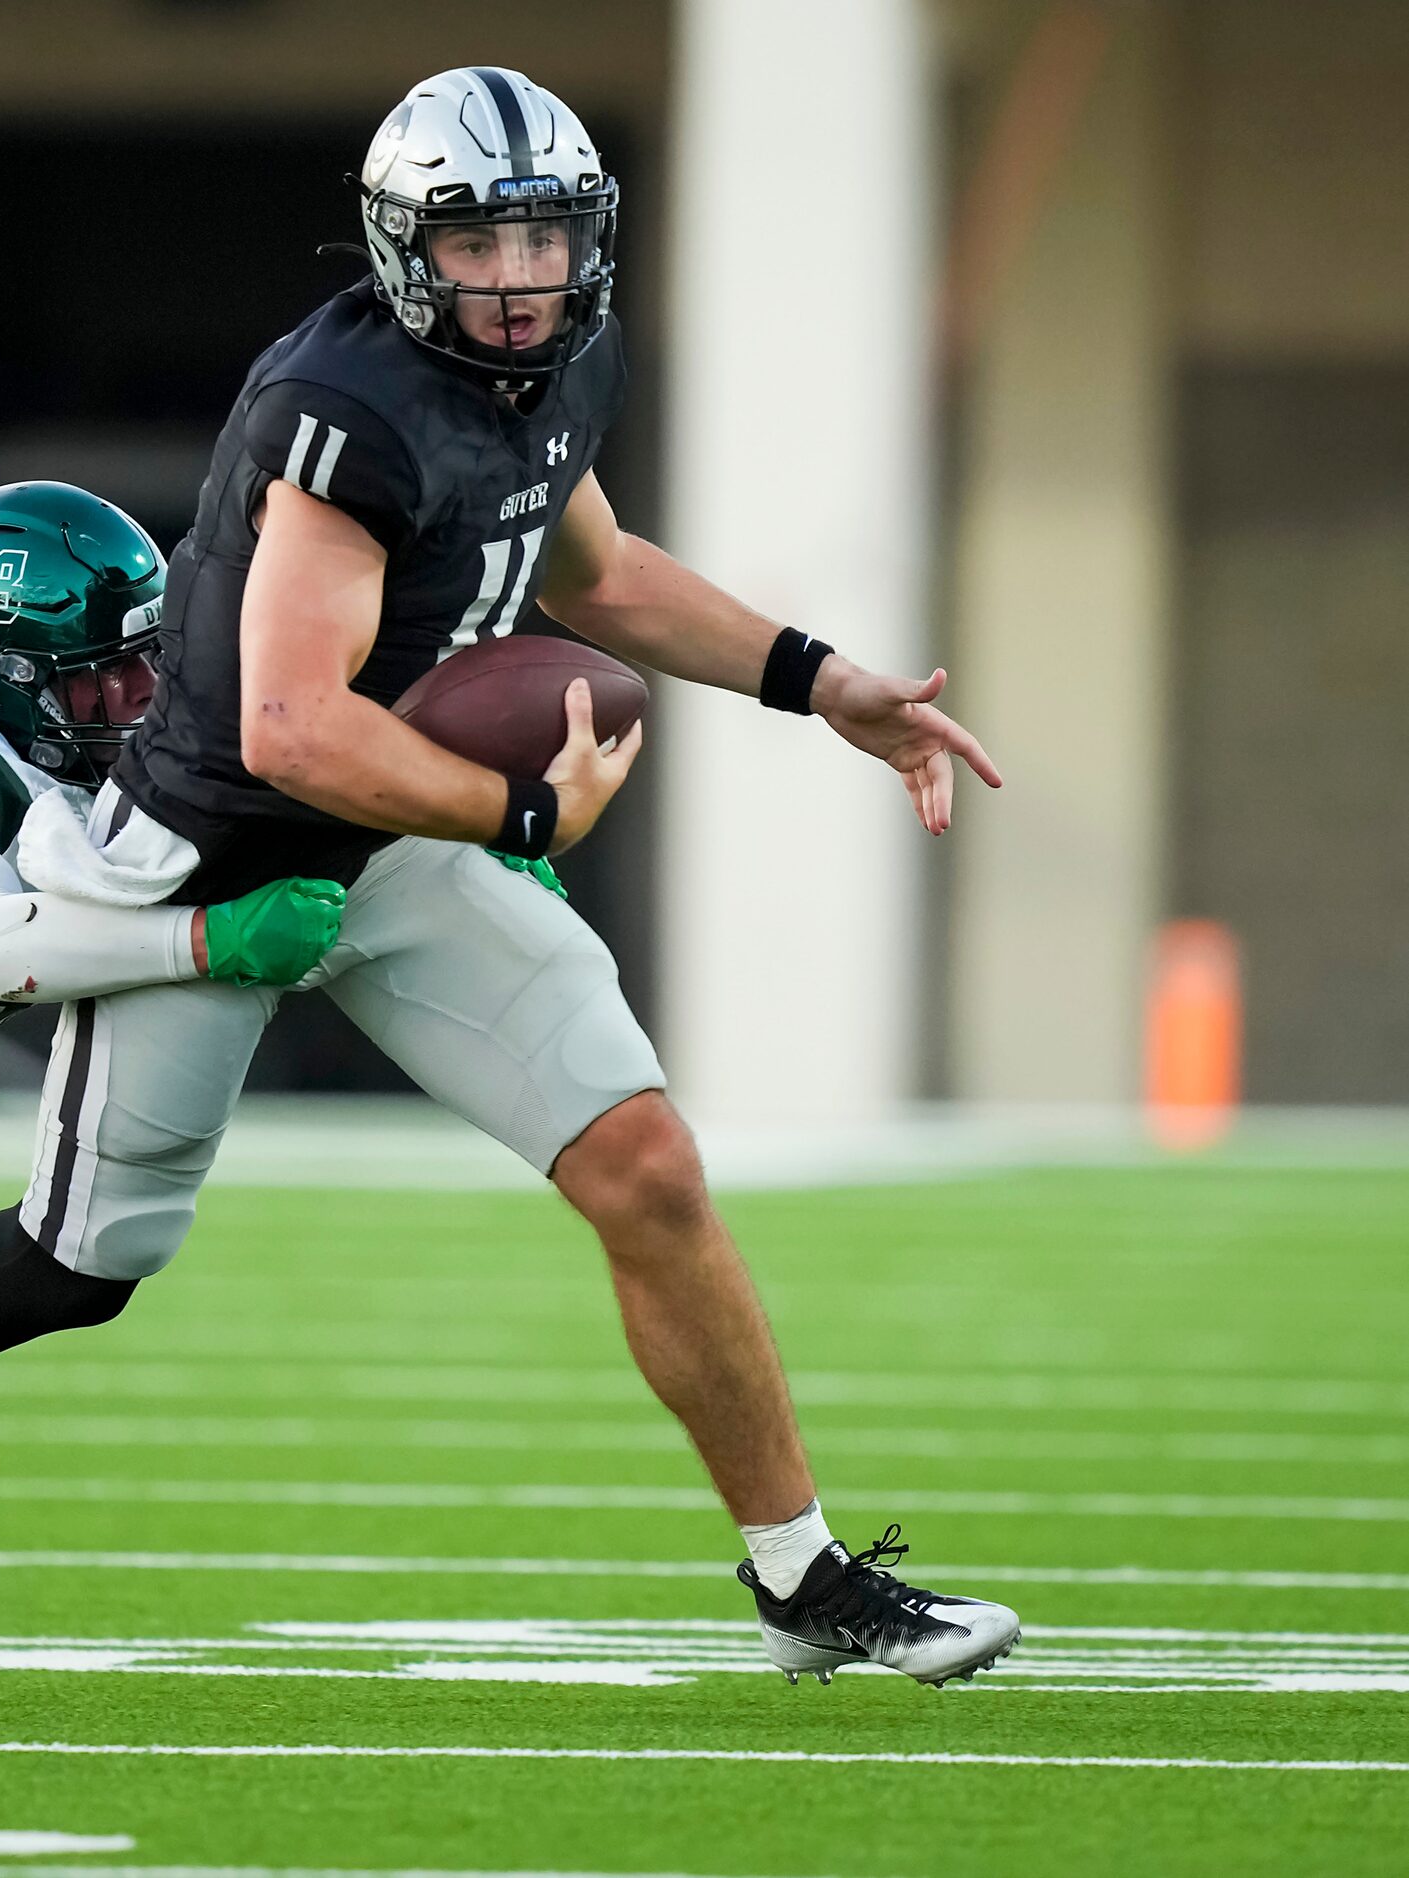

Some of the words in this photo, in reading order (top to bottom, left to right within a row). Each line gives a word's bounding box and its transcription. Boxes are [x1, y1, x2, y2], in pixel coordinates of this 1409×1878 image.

[498, 178, 559, 198] WILDCATS
[283, 412, 349, 501] 11
[499, 481, 549, 521] GUYER
[436, 525, 546, 665] 11
